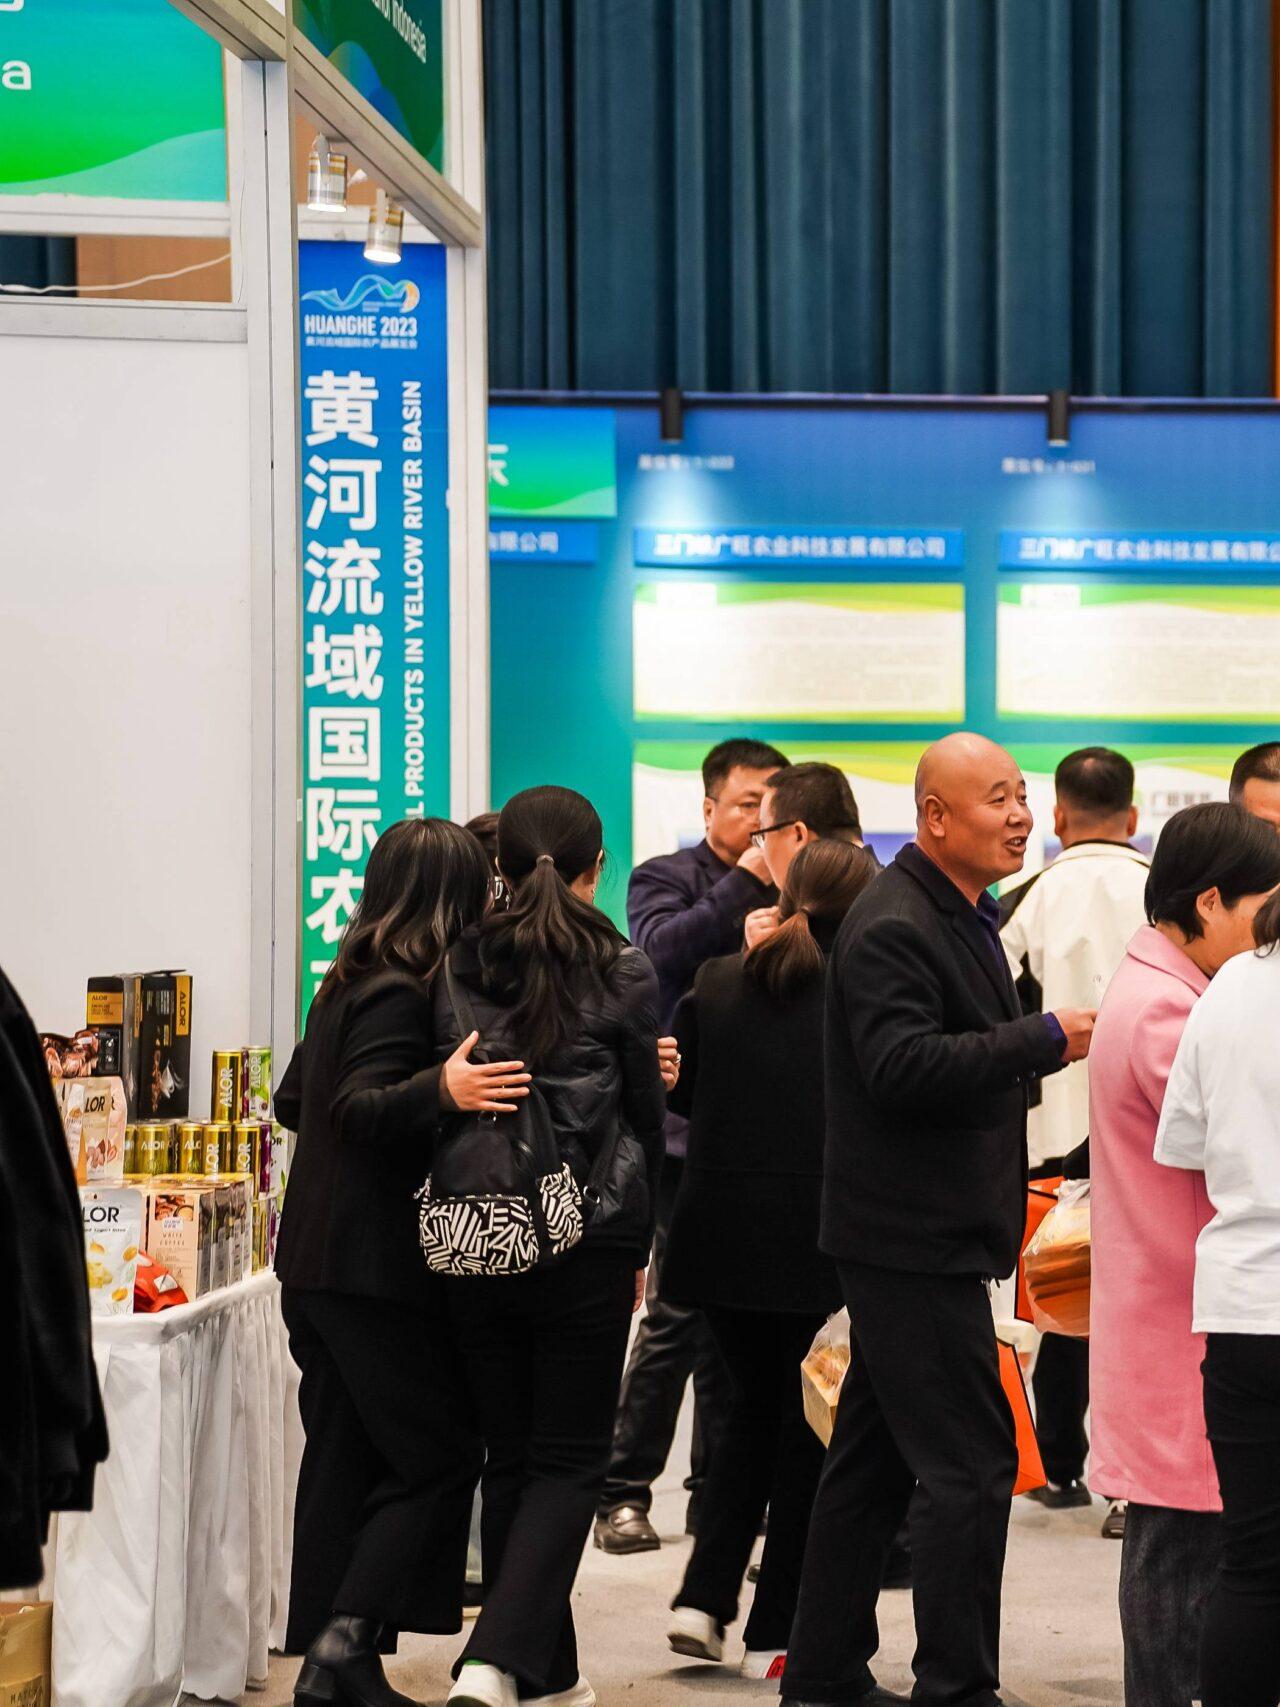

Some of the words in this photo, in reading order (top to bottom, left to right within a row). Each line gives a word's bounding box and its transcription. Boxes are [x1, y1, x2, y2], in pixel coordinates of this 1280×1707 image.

[304, 315, 377, 335] HUANGHE
[380, 316, 417, 336] 2023
[403, 381, 422, 452] BASIN
[403, 459, 423, 529] RIVER
[404, 535, 424, 633] YELLOW
[404, 638, 424, 663] IN
[304, 370, 384, 1000] 黄河流域国际农
[405, 669, 424, 797] PRODUCTS
[84, 1096, 106, 1113] LOR
[220, 1068, 233, 1107] ALOR
[79, 1206, 119, 1223] LOR
